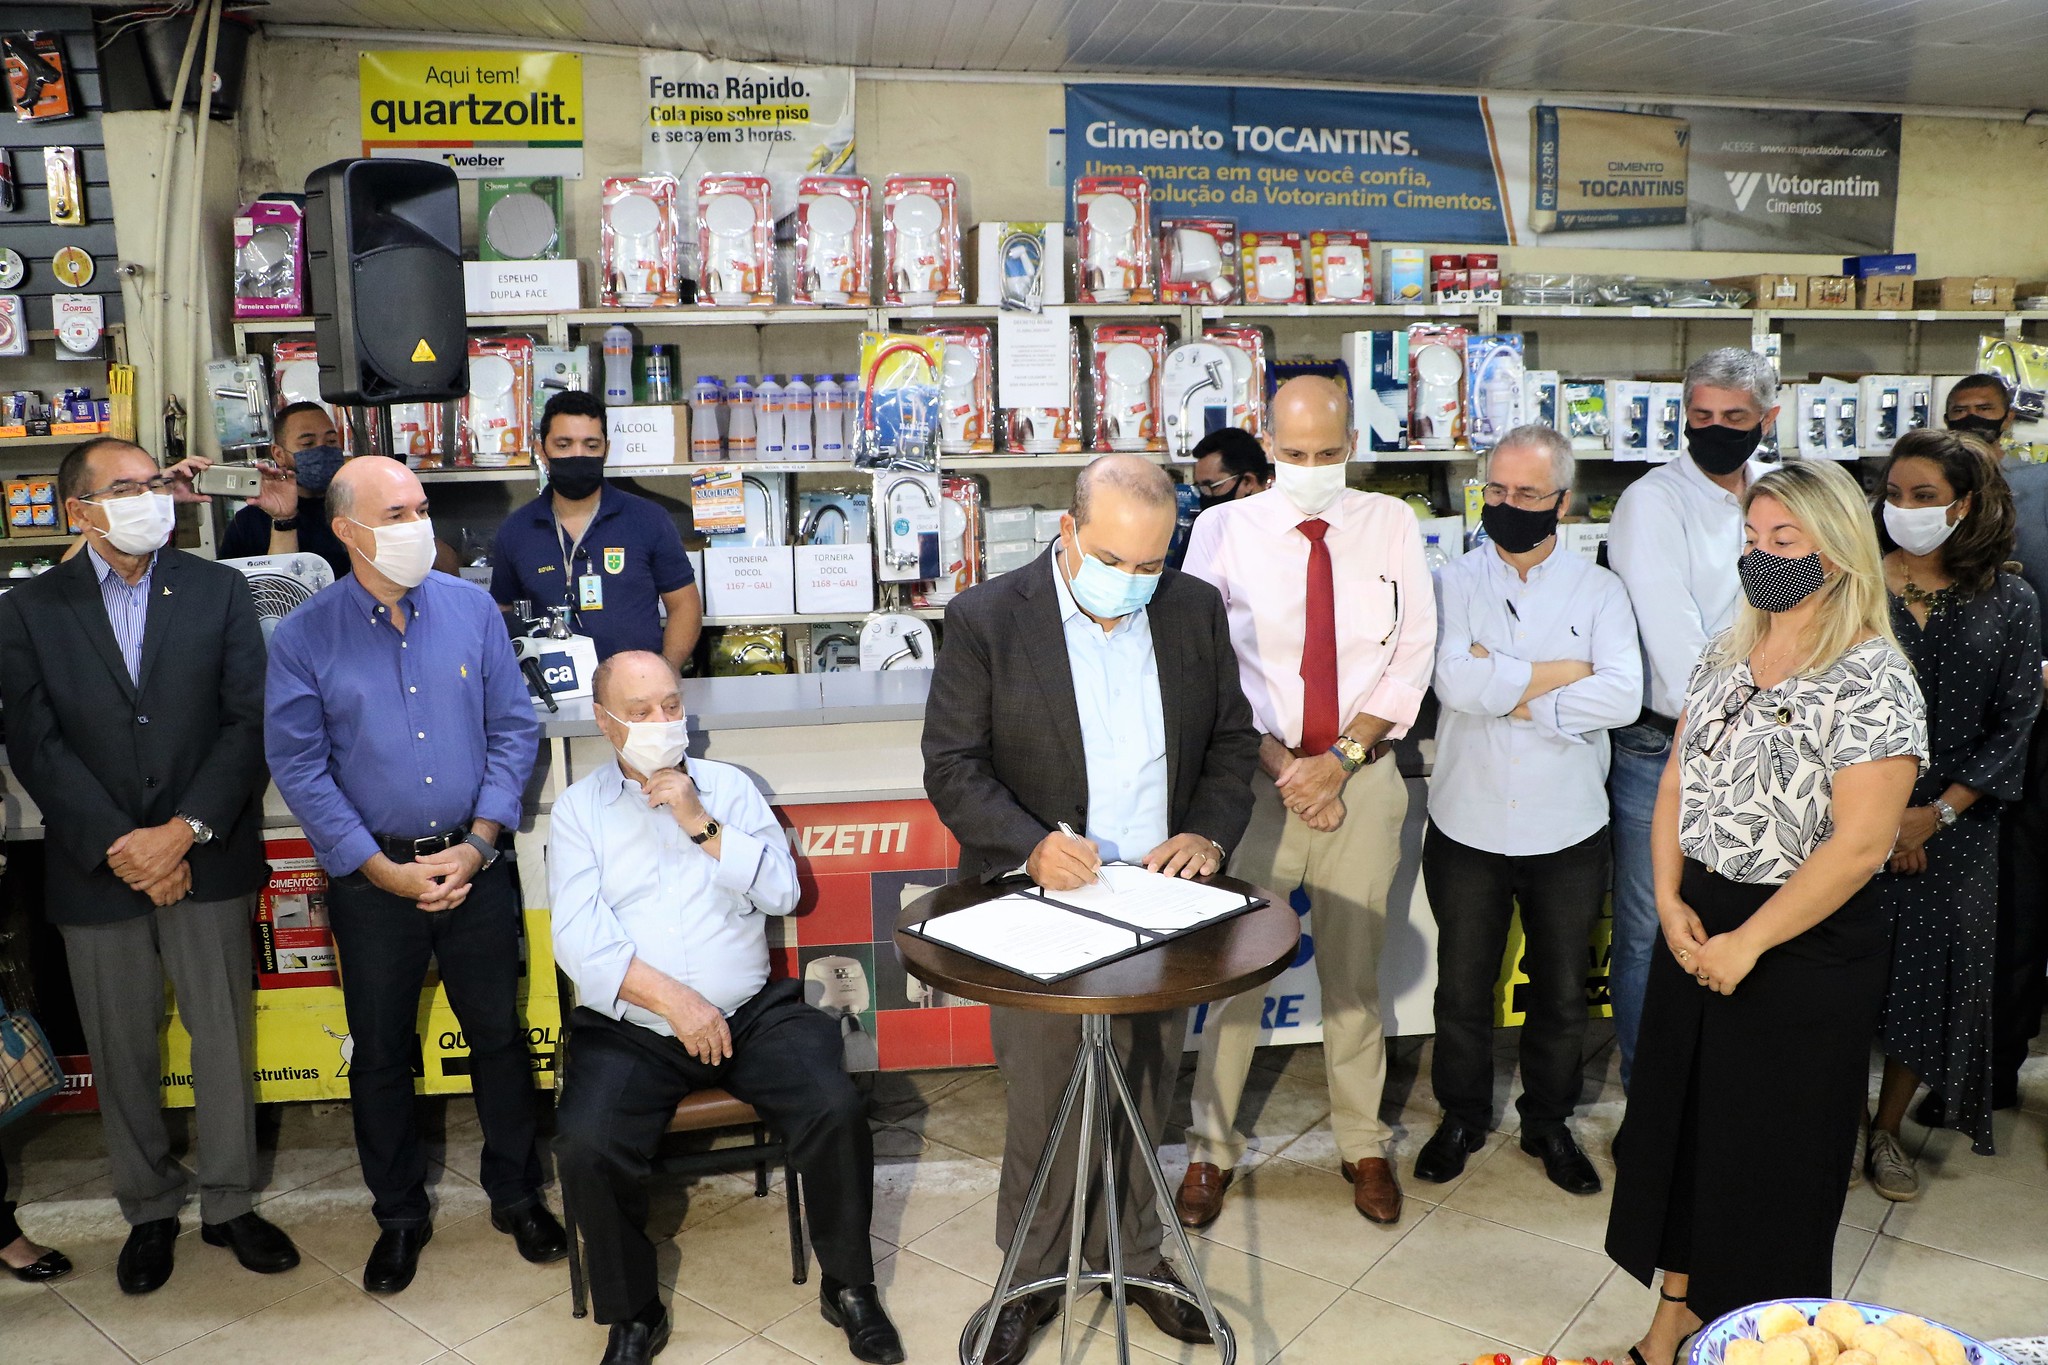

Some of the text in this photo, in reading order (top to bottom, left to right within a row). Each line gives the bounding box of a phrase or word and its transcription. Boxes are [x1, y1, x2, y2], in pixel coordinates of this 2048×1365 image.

[425, 66, 520, 88] Aqui tem!
[649, 76, 811, 105] Ferma Rápido.
[370, 92, 576, 133] quartzolit.
[650, 104, 810, 125] Cola piso sobre piso
[651, 127, 797, 144] e seca em 3 horas.
[1085, 121, 1419, 157] Cimento TOCANTINS.
[1720, 141, 1888, 158] ACESSE www.mapadaobra.com.br
[455, 153, 505, 167] weber
[1607, 161, 1665, 173] CIMENTO
[1085, 160, 1432, 189] Uma marca em que você confia,
[1579, 179, 1685, 198] TOCANTINS
[1766, 172, 1880, 197] Votorantim
[1151, 182, 1498, 212] olução da Votorantim Cimentos.
[1766, 198, 1823, 215] Cimentos
[498, 273, 539, 284] ESPELHO
[490, 289, 548, 299] DUPLA FACE
[62, 303, 92, 312] CORTAG
[238, 303, 265, 311] Torneira
[280, 303, 299, 311] Filtro
[613, 421, 658, 433] ÁLCOOL
[626, 443, 647, 453] GEL
[728, 555, 769, 564] TORNEIRA
[814, 553, 855, 562] TORNEIRA
[734, 568, 763, 577] DOCOL
[820, 566, 848, 575] DOCOL
[726, 582, 745, 591] 1167
[754, 582, 773, 590] GALI
[811, 580, 831, 588] 1168
[784, 822, 910, 858] NZETTI
[269, 877, 328, 889] CIMENTCOL
[260, 923, 274, 971] weber.col
[63, 1074, 93, 1088] ETTI
[160, 1073, 194, 1089] oluç
[253, 1066, 320, 1082] strutivas
